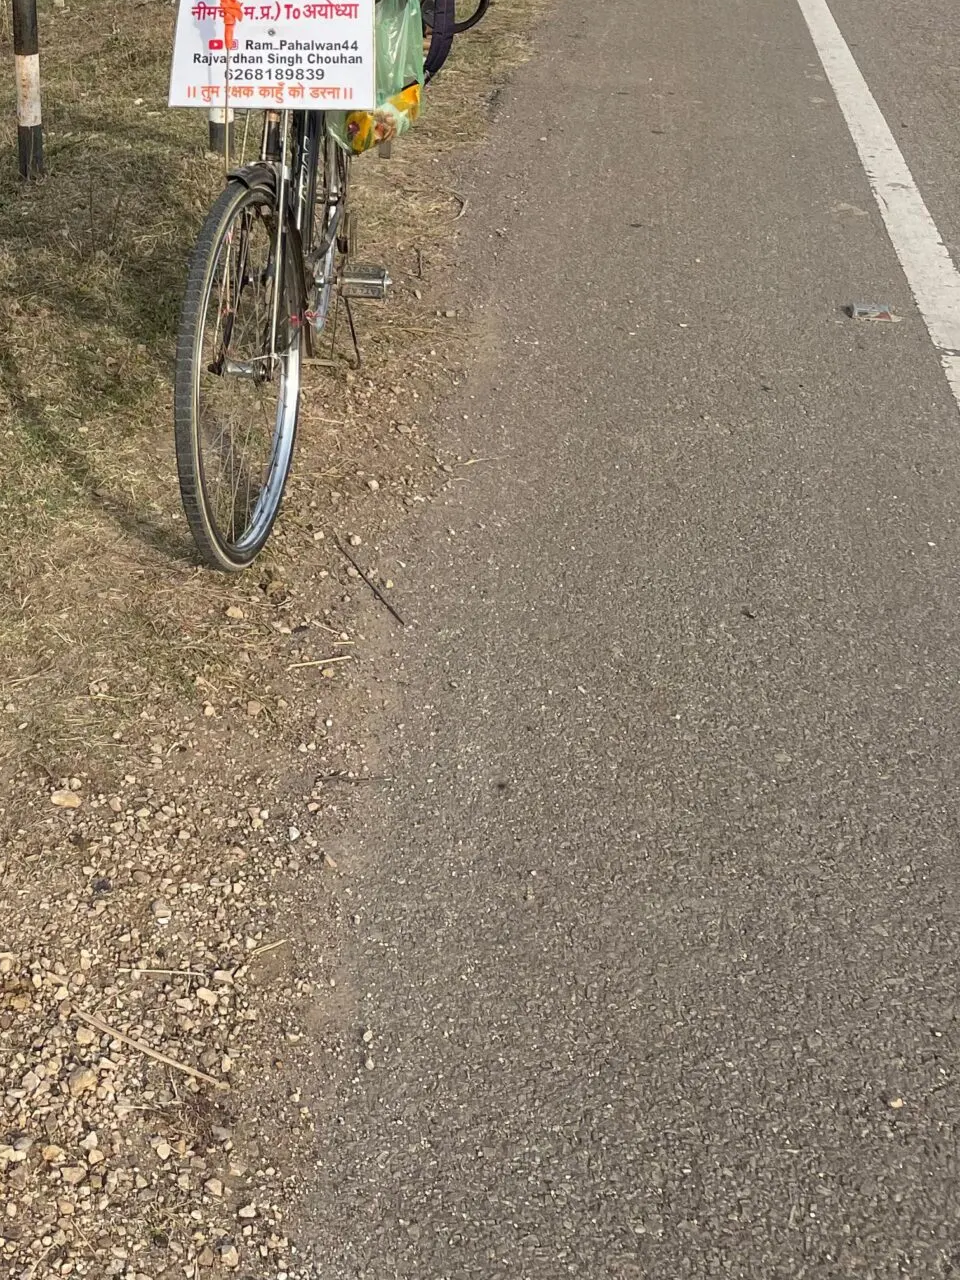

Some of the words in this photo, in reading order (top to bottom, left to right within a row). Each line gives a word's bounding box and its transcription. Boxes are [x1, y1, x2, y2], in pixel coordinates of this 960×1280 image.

[240, 1, 281, 22] म.प्र.)
[284, 4, 300, 20] To
[245, 39, 359, 51] Ram_Pahalwan44
[267, 53, 303, 67] Singh
[307, 53, 363, 64] Chouhan
[224, 68, 325, 81] 6268189839
[200, 85, 220, 102] तुम
[287, 82, 305, 99] को
